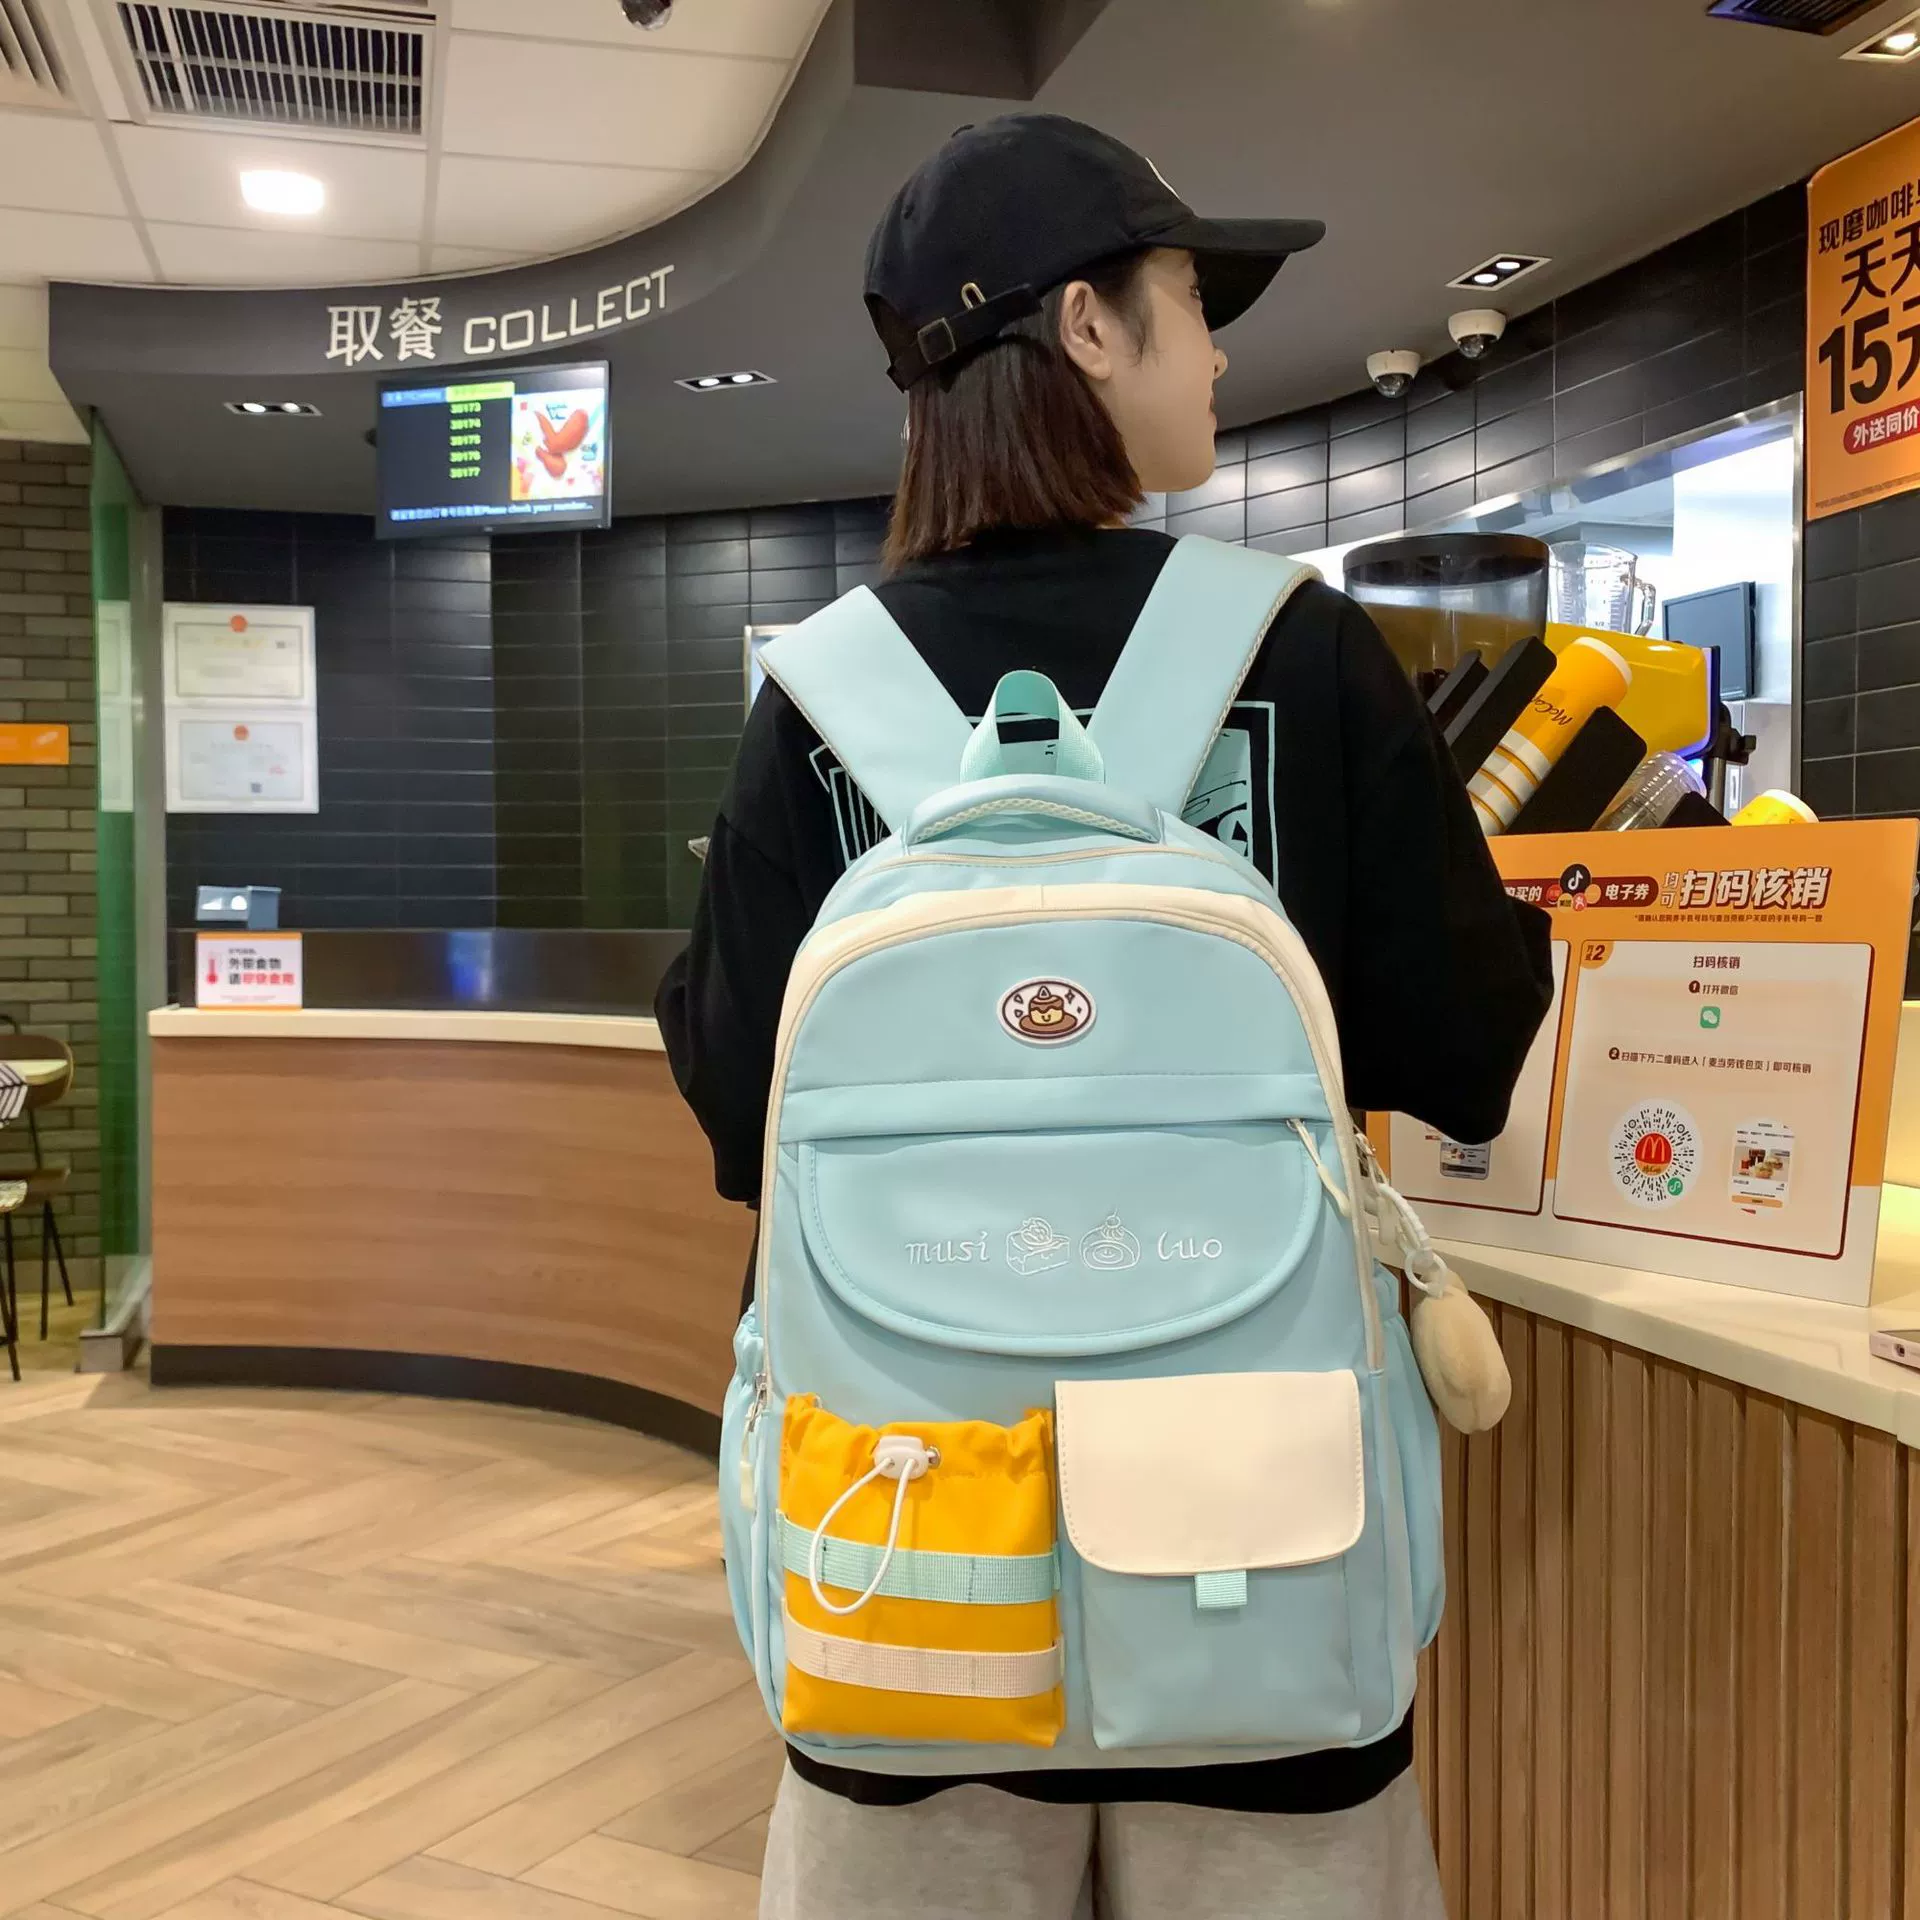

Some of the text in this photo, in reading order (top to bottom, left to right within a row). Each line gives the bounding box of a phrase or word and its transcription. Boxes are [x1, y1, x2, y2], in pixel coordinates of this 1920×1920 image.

[1818, 179, 1920, 255] 现磨咖啡
[1841, 220, 1920, 316] 天天
[325, 264, 675, 366] 取餐 COLLECT
[1853, 405, 1920, 448] 外送同价
[1605, 883, 1649, 901] 电子券
[1679, 867, 1832, 910] 扫码核销
[1693, 956, 1741, 970] 扫码核销
[905, 1230, 991, 1264] musi
